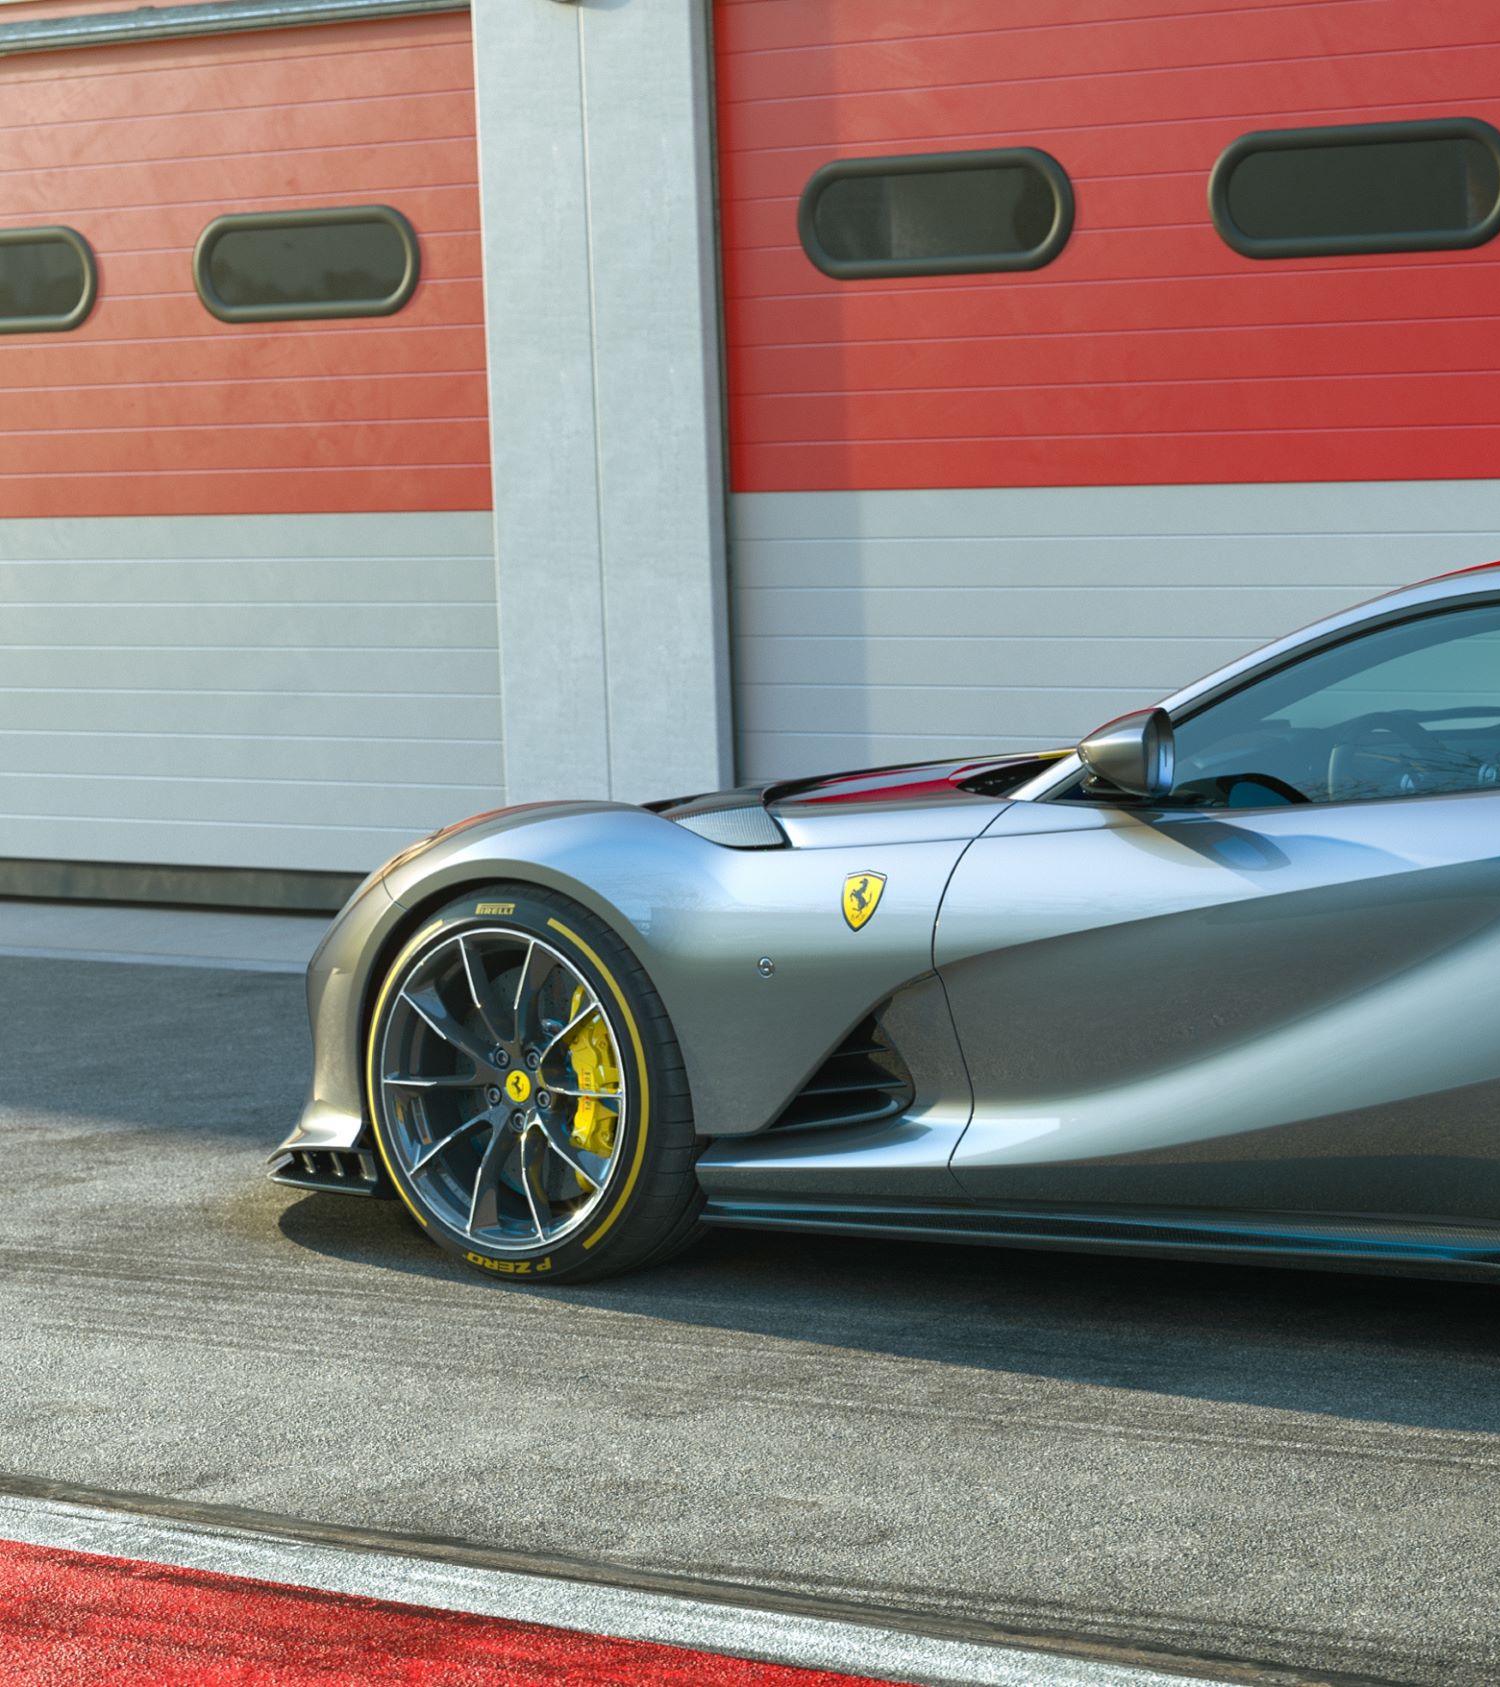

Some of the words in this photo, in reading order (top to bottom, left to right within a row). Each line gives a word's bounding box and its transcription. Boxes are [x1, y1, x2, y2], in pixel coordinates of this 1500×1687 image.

[475, 903, 516, 915] PIRELLI
[466, 1251, 532, 1274] ZERO
[536, 1256, 552, 1272] P
